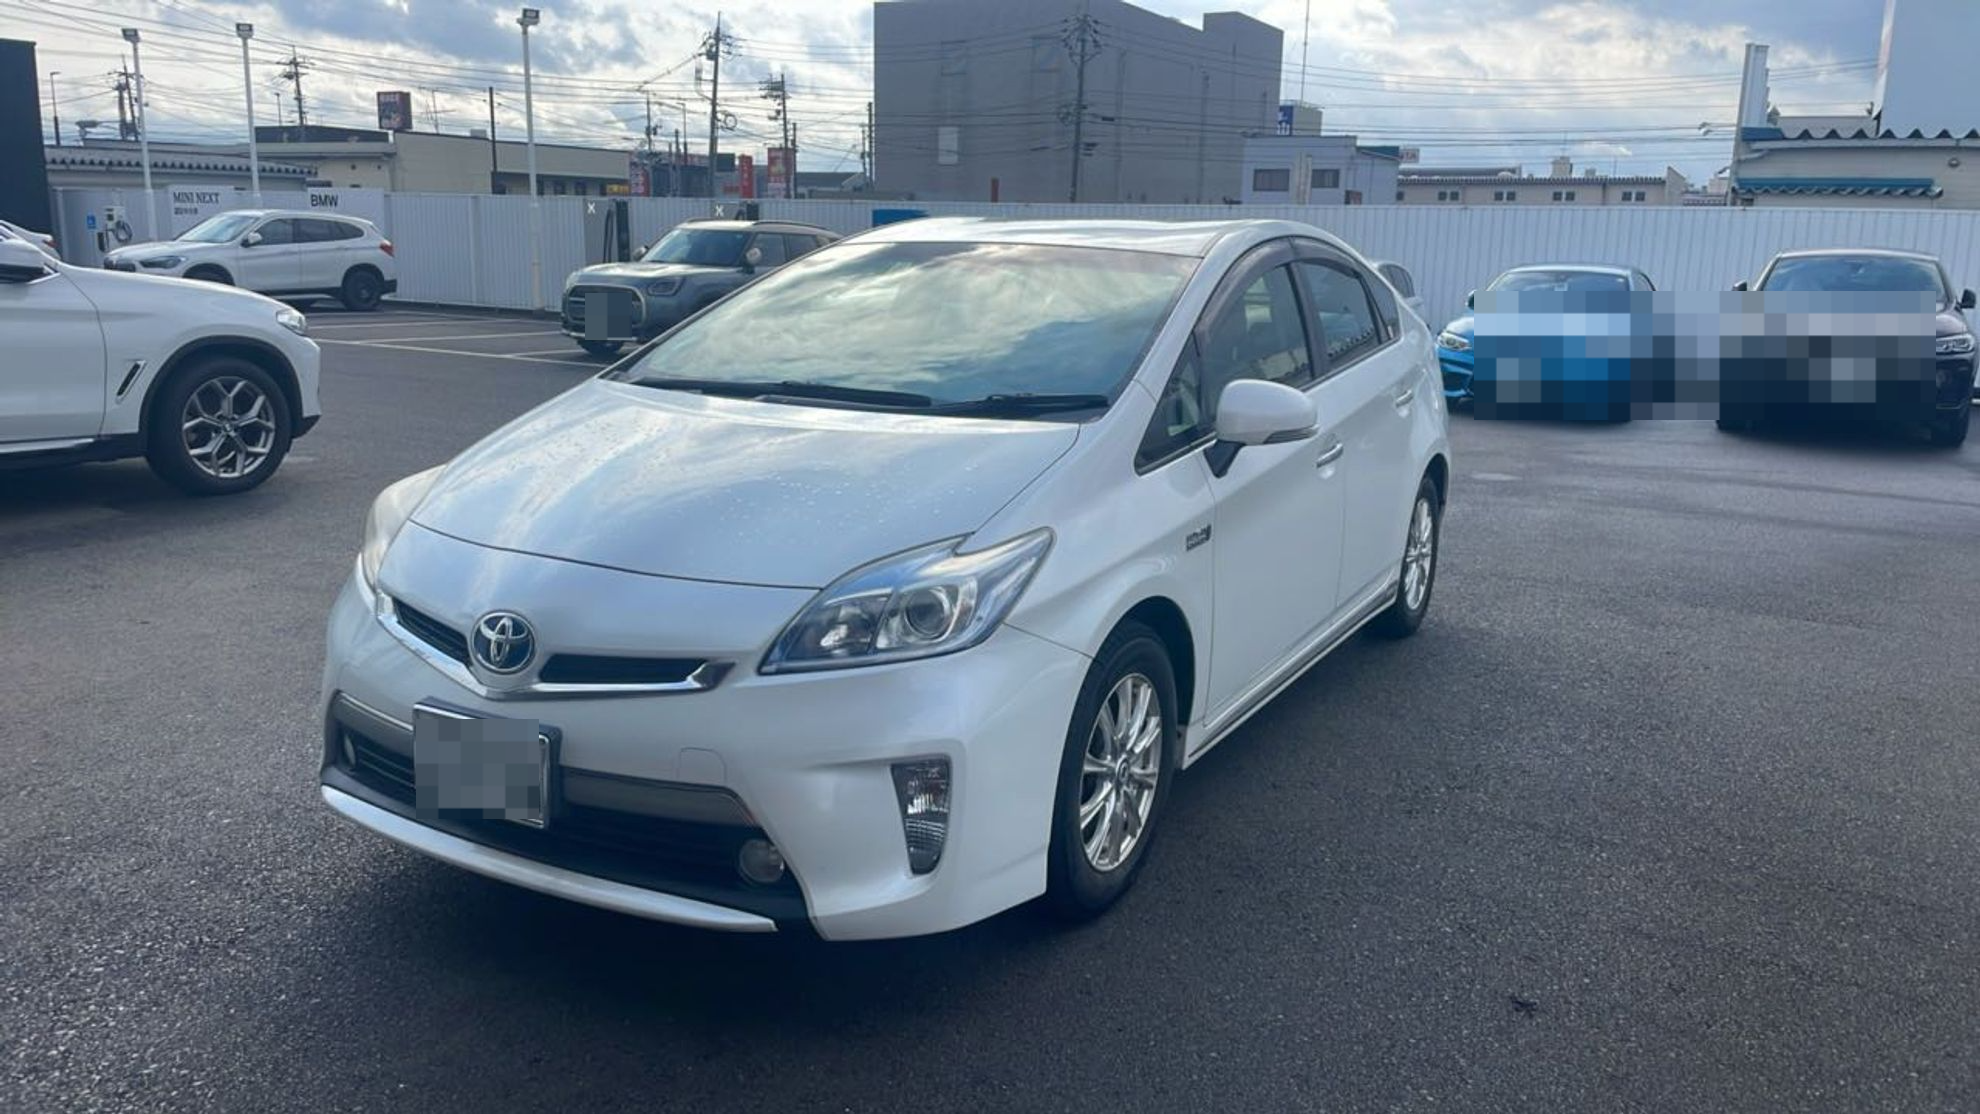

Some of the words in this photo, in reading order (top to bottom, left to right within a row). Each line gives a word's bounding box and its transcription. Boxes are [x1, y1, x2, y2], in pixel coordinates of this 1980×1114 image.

[173, 191, 194, 204] MINI
[195, 191, 220, 204] NEXT
[310, 193, 339, 207] BMW
